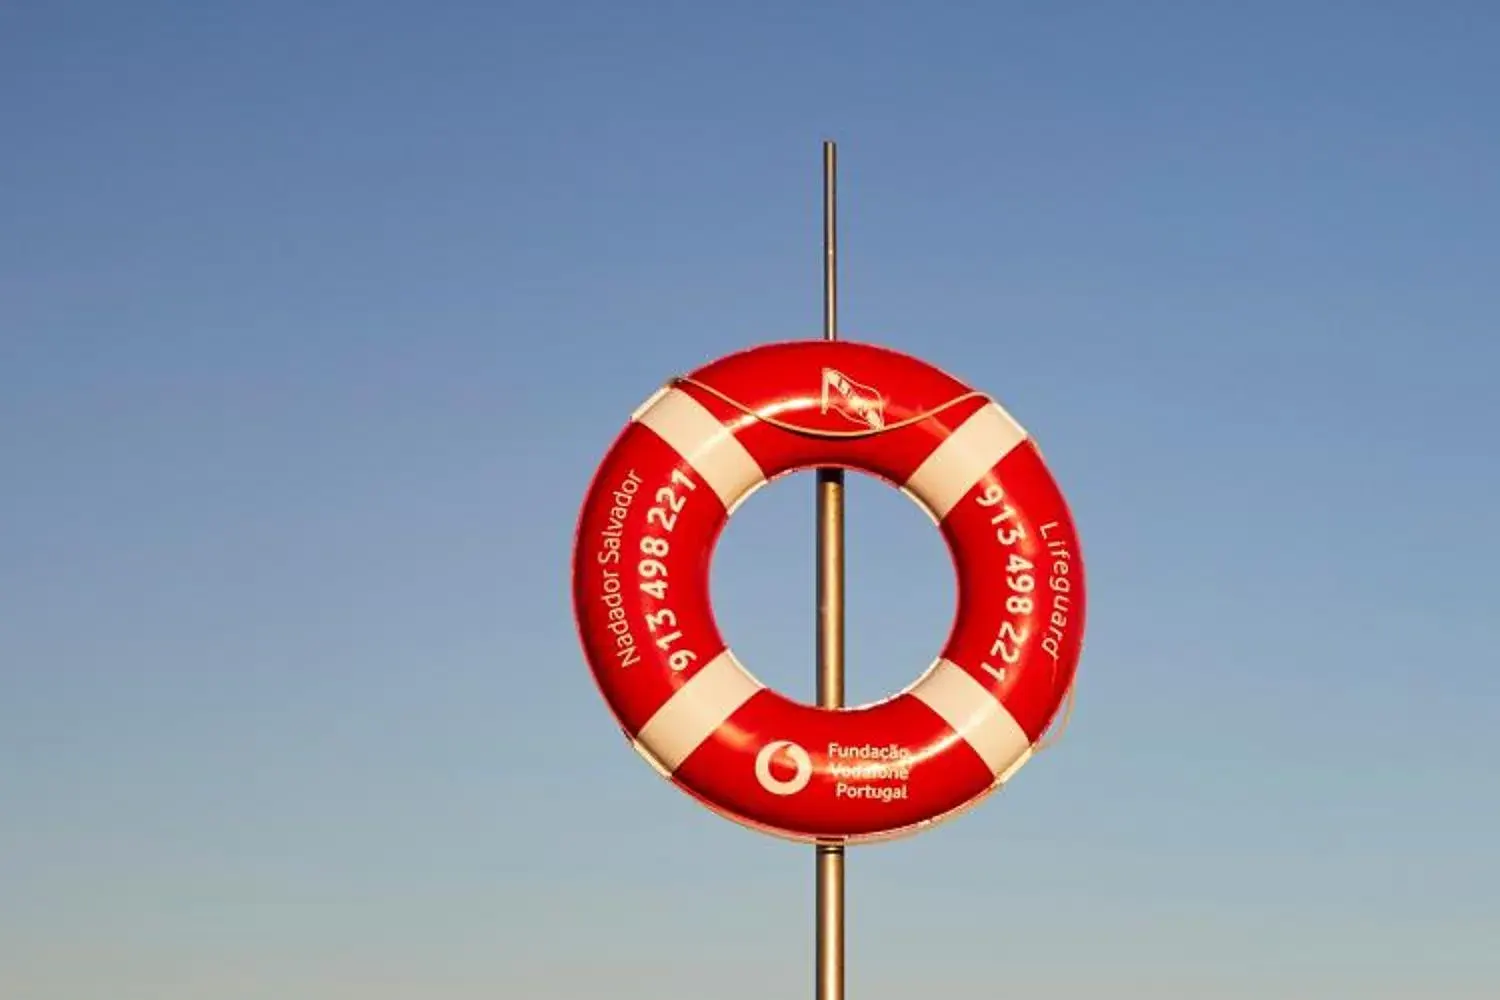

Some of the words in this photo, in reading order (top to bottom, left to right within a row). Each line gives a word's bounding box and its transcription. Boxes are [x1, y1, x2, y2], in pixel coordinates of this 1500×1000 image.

[597, 468, 644, 565] Salvador
[647, 468, 697, 532] 221
[975, 483, 1026, 546] 913
[638, 536, 669, 600] 498
[1005, 553, 1035, 615] 498
[1040, 521, 1071, 660] Lifeguard
[601, 568, 641, 668] Nadador
[644, 608, 698, 671] 913
[980, 621, 1029, 682] 221
[828, 742, 910, 760] Fundação
[836, 783, 908, 802] Portugal
